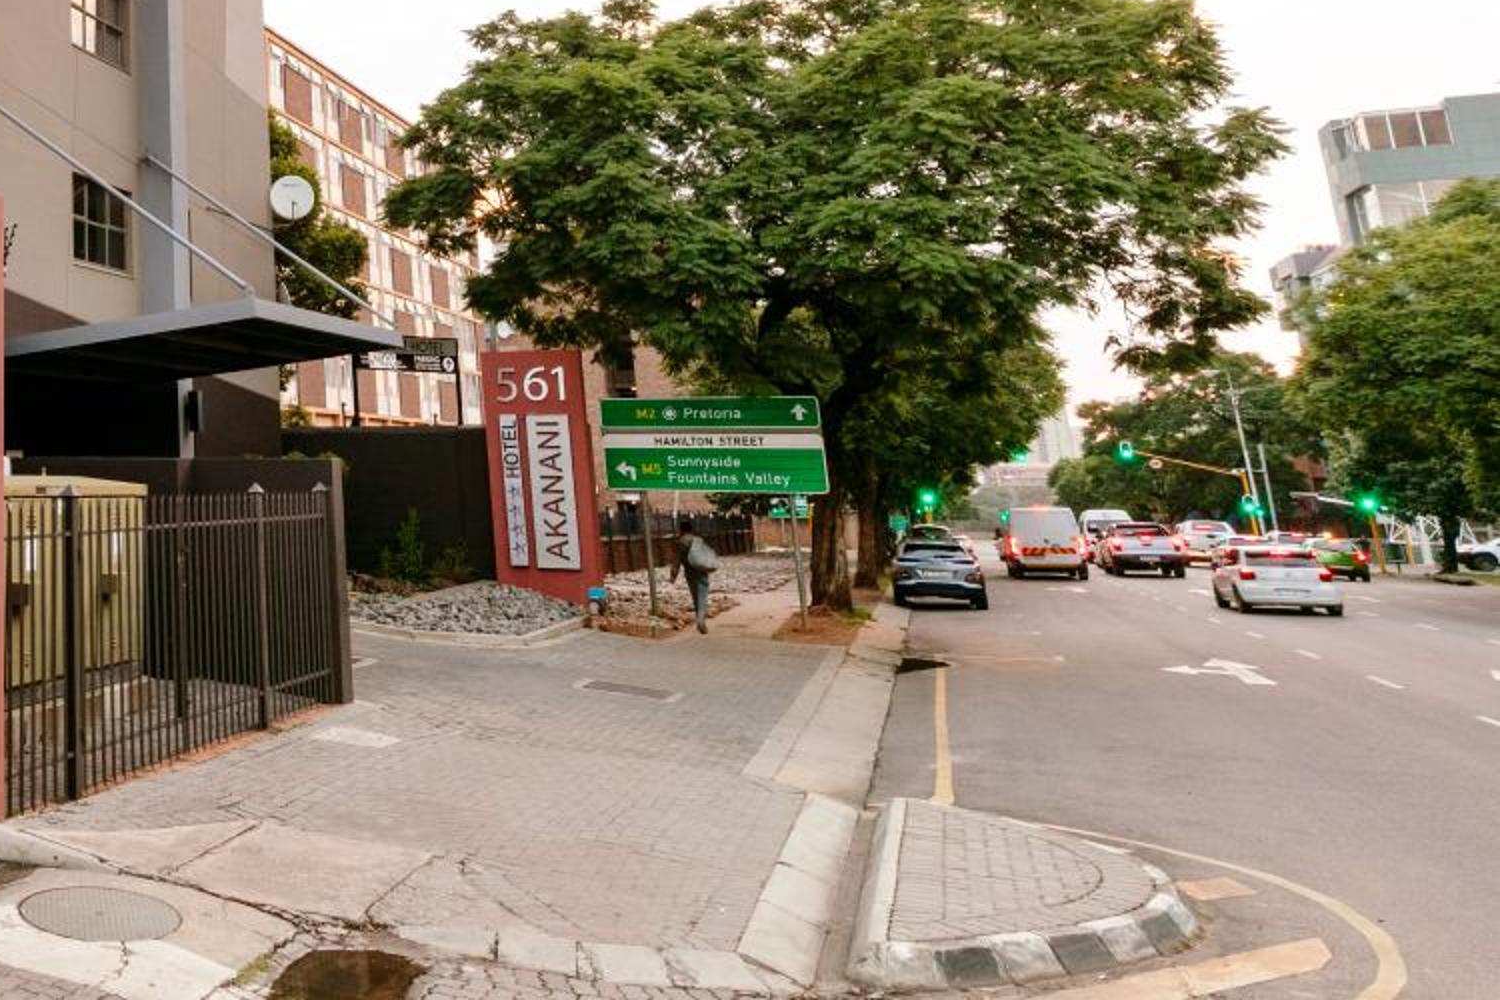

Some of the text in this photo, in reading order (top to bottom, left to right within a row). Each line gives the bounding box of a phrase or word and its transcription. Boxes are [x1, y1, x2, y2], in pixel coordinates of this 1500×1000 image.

[496, 366, 566, 402] 561
[683, 407, 742, 420] Pretoria
[501, 420, 520, 479] HOTEL
[653, 436, 765, 447] HAMILTON STREET
[667, 455, 741, 470] Sunnyside
[667, 471, 791, 488] Fountains Valley
[536, 421, 571, 561] AKANANI
